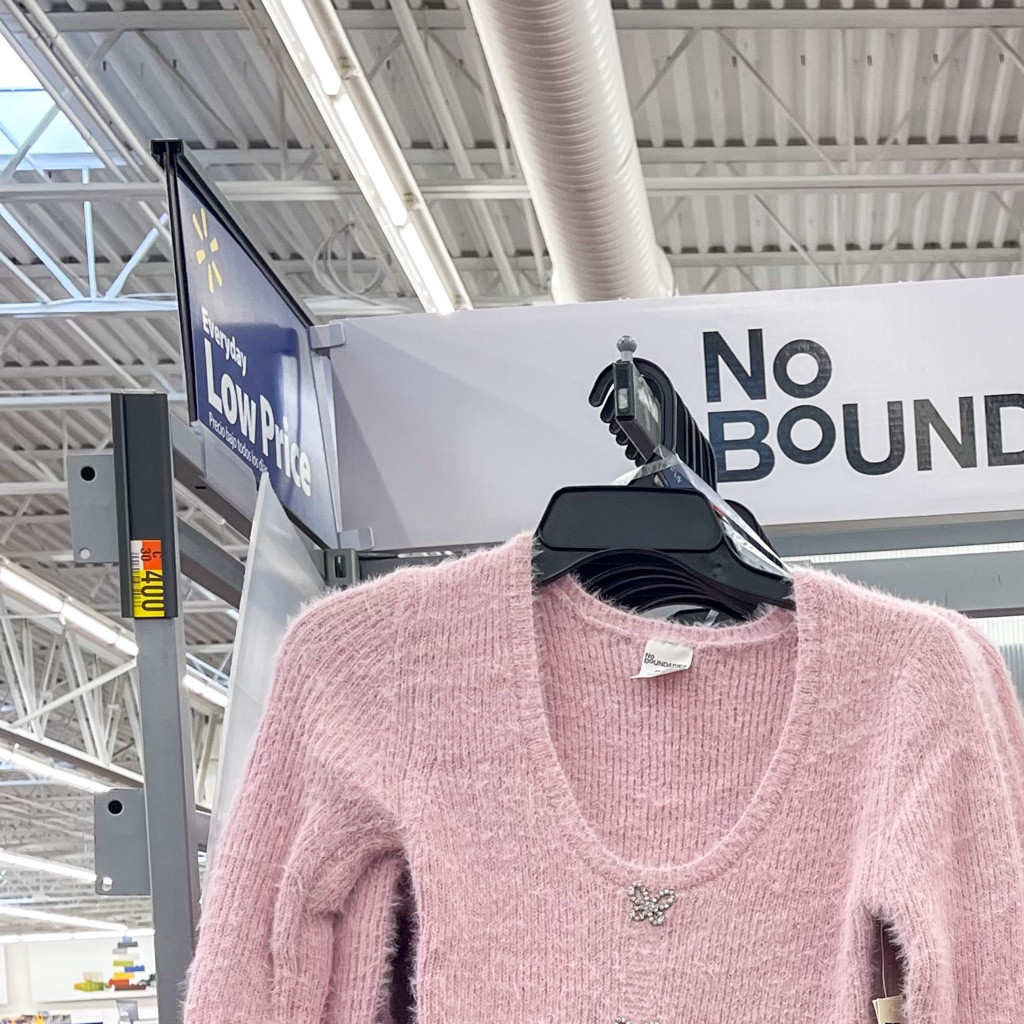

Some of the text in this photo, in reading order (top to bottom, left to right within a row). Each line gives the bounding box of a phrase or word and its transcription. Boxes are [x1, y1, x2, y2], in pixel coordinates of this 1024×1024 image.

[200, 306, 247, 377] Everyday
[204, 338, 311, 497] Low Price
[208, 411, 225, 438] Precio
[140, 548, 151, 562] 30
